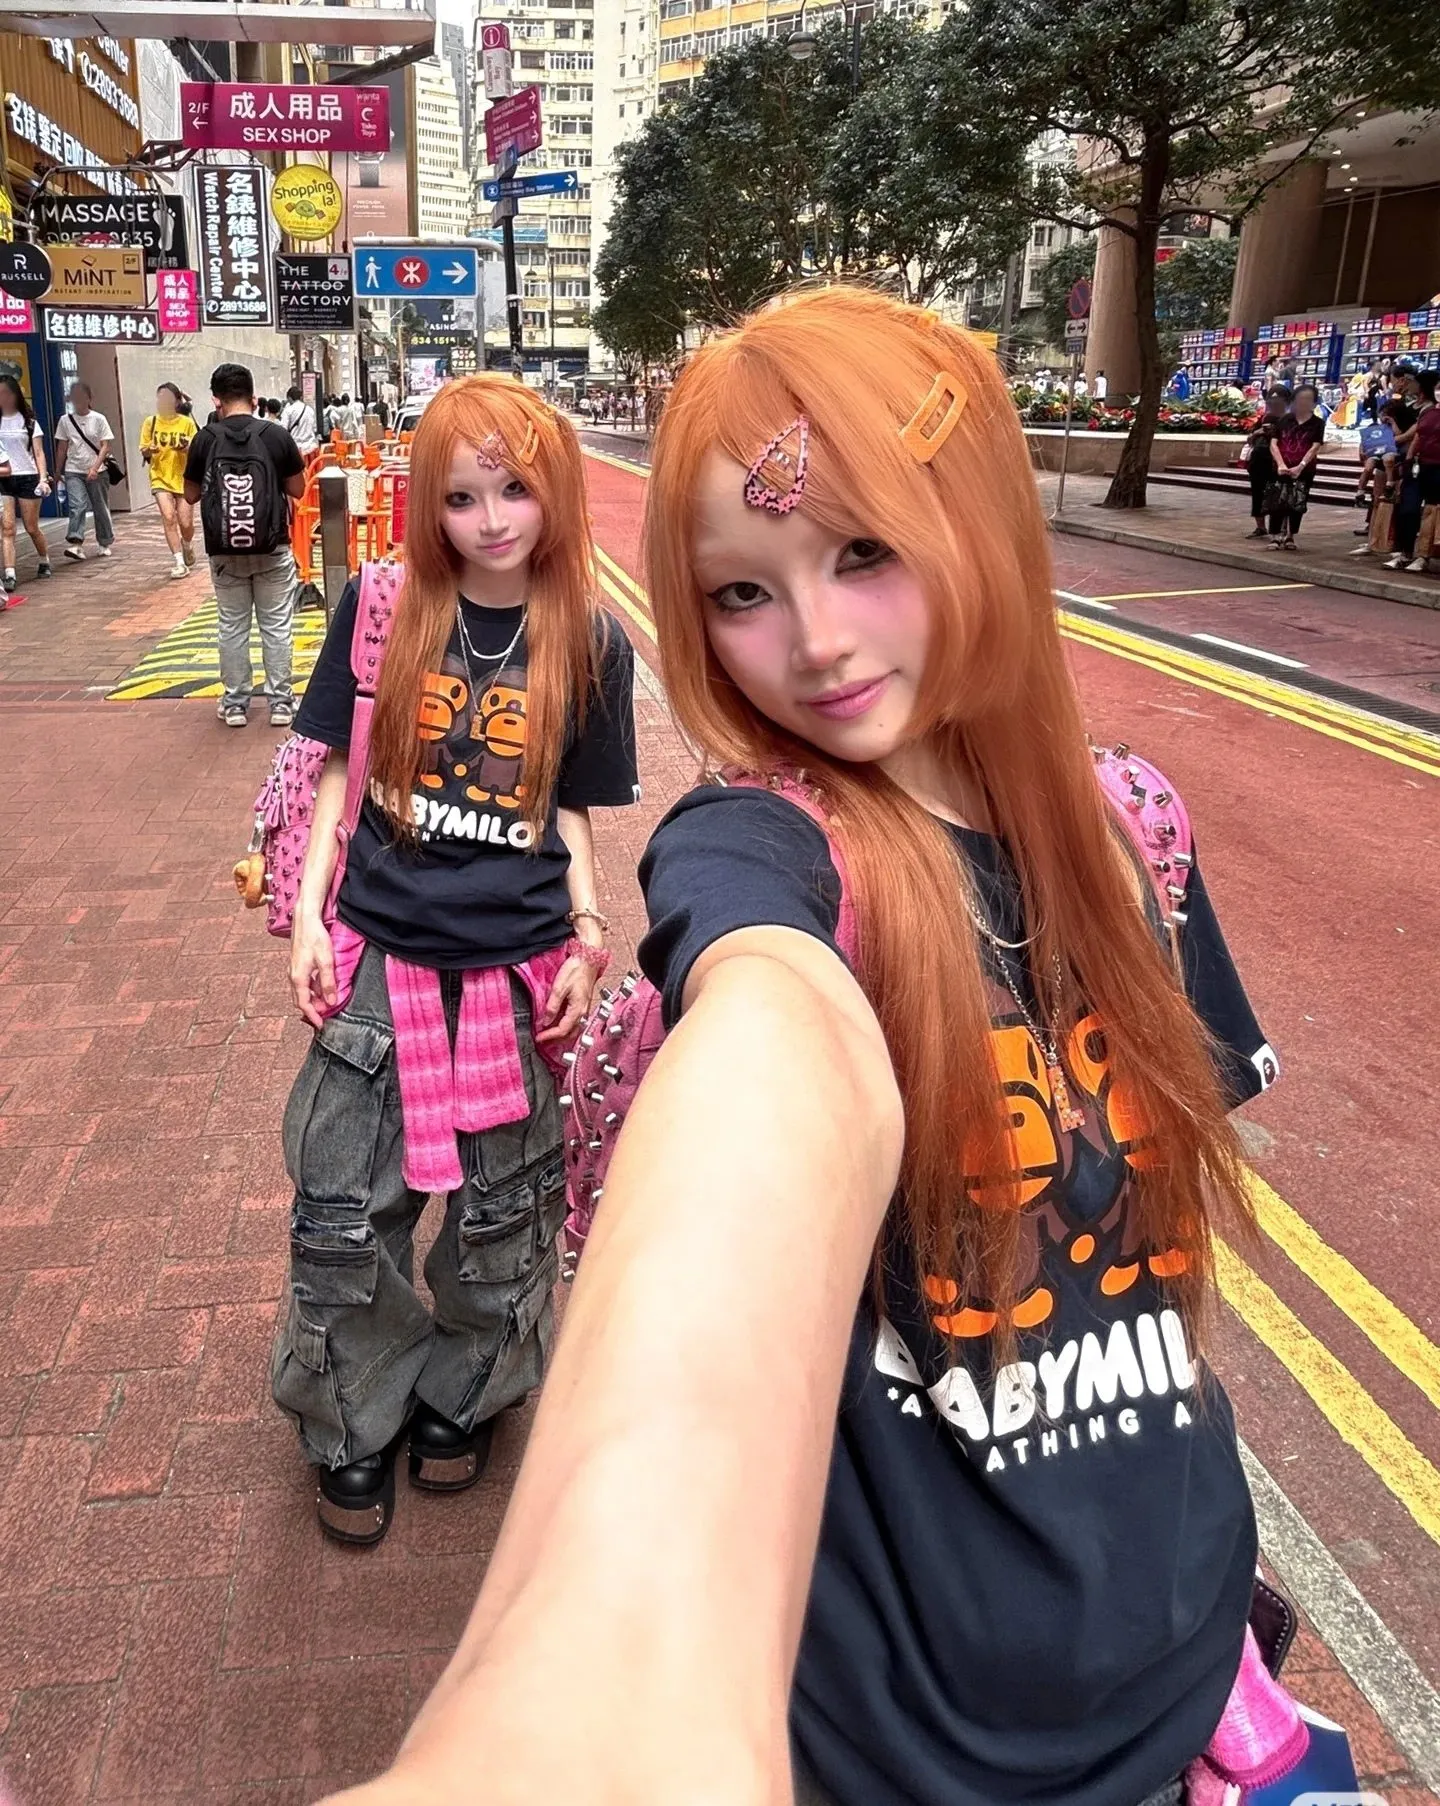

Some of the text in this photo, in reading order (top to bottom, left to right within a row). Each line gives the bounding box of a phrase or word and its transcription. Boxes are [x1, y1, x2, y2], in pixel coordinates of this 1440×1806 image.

[188, 102, 210, 114] 2/F
[229, 91, 343, 122] 成人用品
[242, 127, 331, 144] SEX SHOP
[274, 179, 334, 200] Shopping
[322, 193, 336, 207] la!
[41, 203, 150, 223] MASSAGE
[203, 171, 224, 299] Watch Repair Center
[1, 272, 45, 281] RUSSELL
[279, 265, 309, 276] THE
[280, 280, 345, 291] TATTOO
[280, 295, 351, 306] FACTORY
[0, 315, 27, 326] HOP
[50, 313, 156, 339] 名錶維修中心
[425, 322, 459, 331] ASING
[370, 777, 537, 849] BYMILO
[986, 1407, 1141, 1473] ATHING
